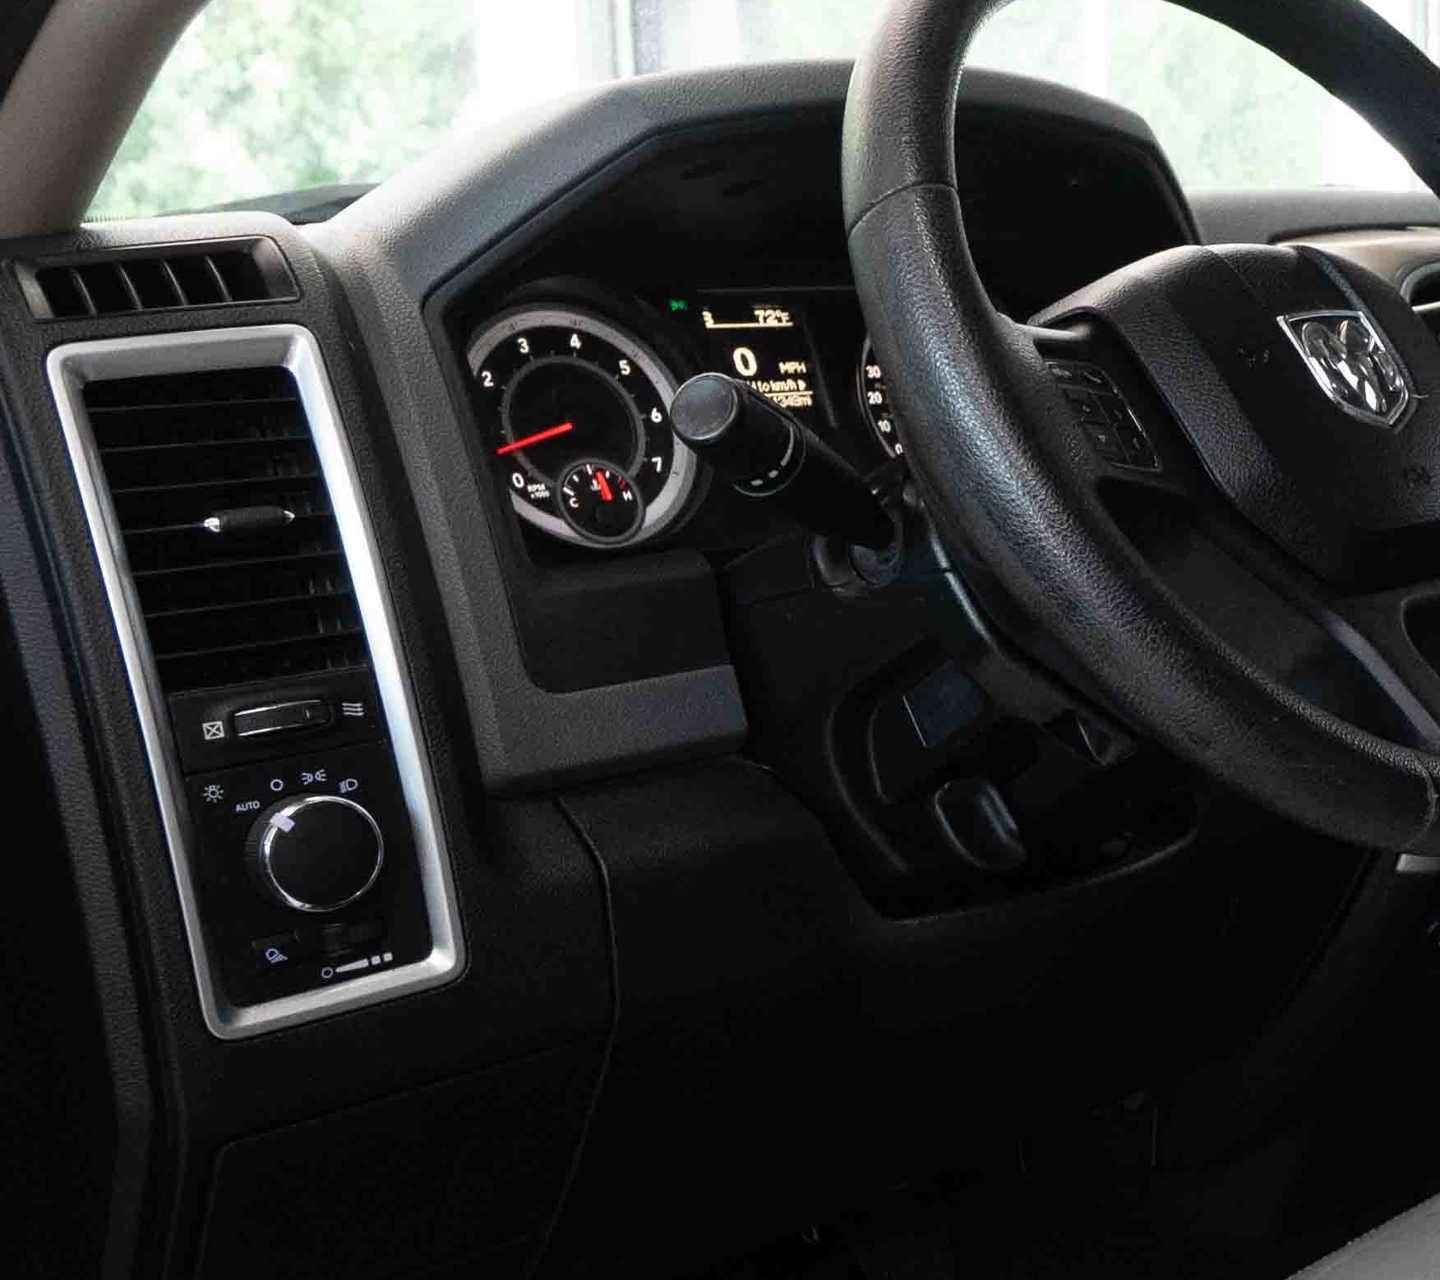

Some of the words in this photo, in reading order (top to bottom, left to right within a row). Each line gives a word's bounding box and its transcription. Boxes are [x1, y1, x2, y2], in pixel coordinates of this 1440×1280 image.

[517, 337, 530, 354] 3
[569, 333, 582, 350] 4
[618, 359, 631, 376] 5
[733, 346, 758, 377] 0
[481, 371, 495, 388] 2
[866, 364, 882, 379] 30
[867, 391, 883, 405] 20
[650, 407, 663, 424] 6
[877, 419, 892, 433] 10
[650, 456, 663, 473] 7
[512, 472, 525, 489] 0
[568, 497, 580, 509] C
[235, 800, 261, 813] AUTO
